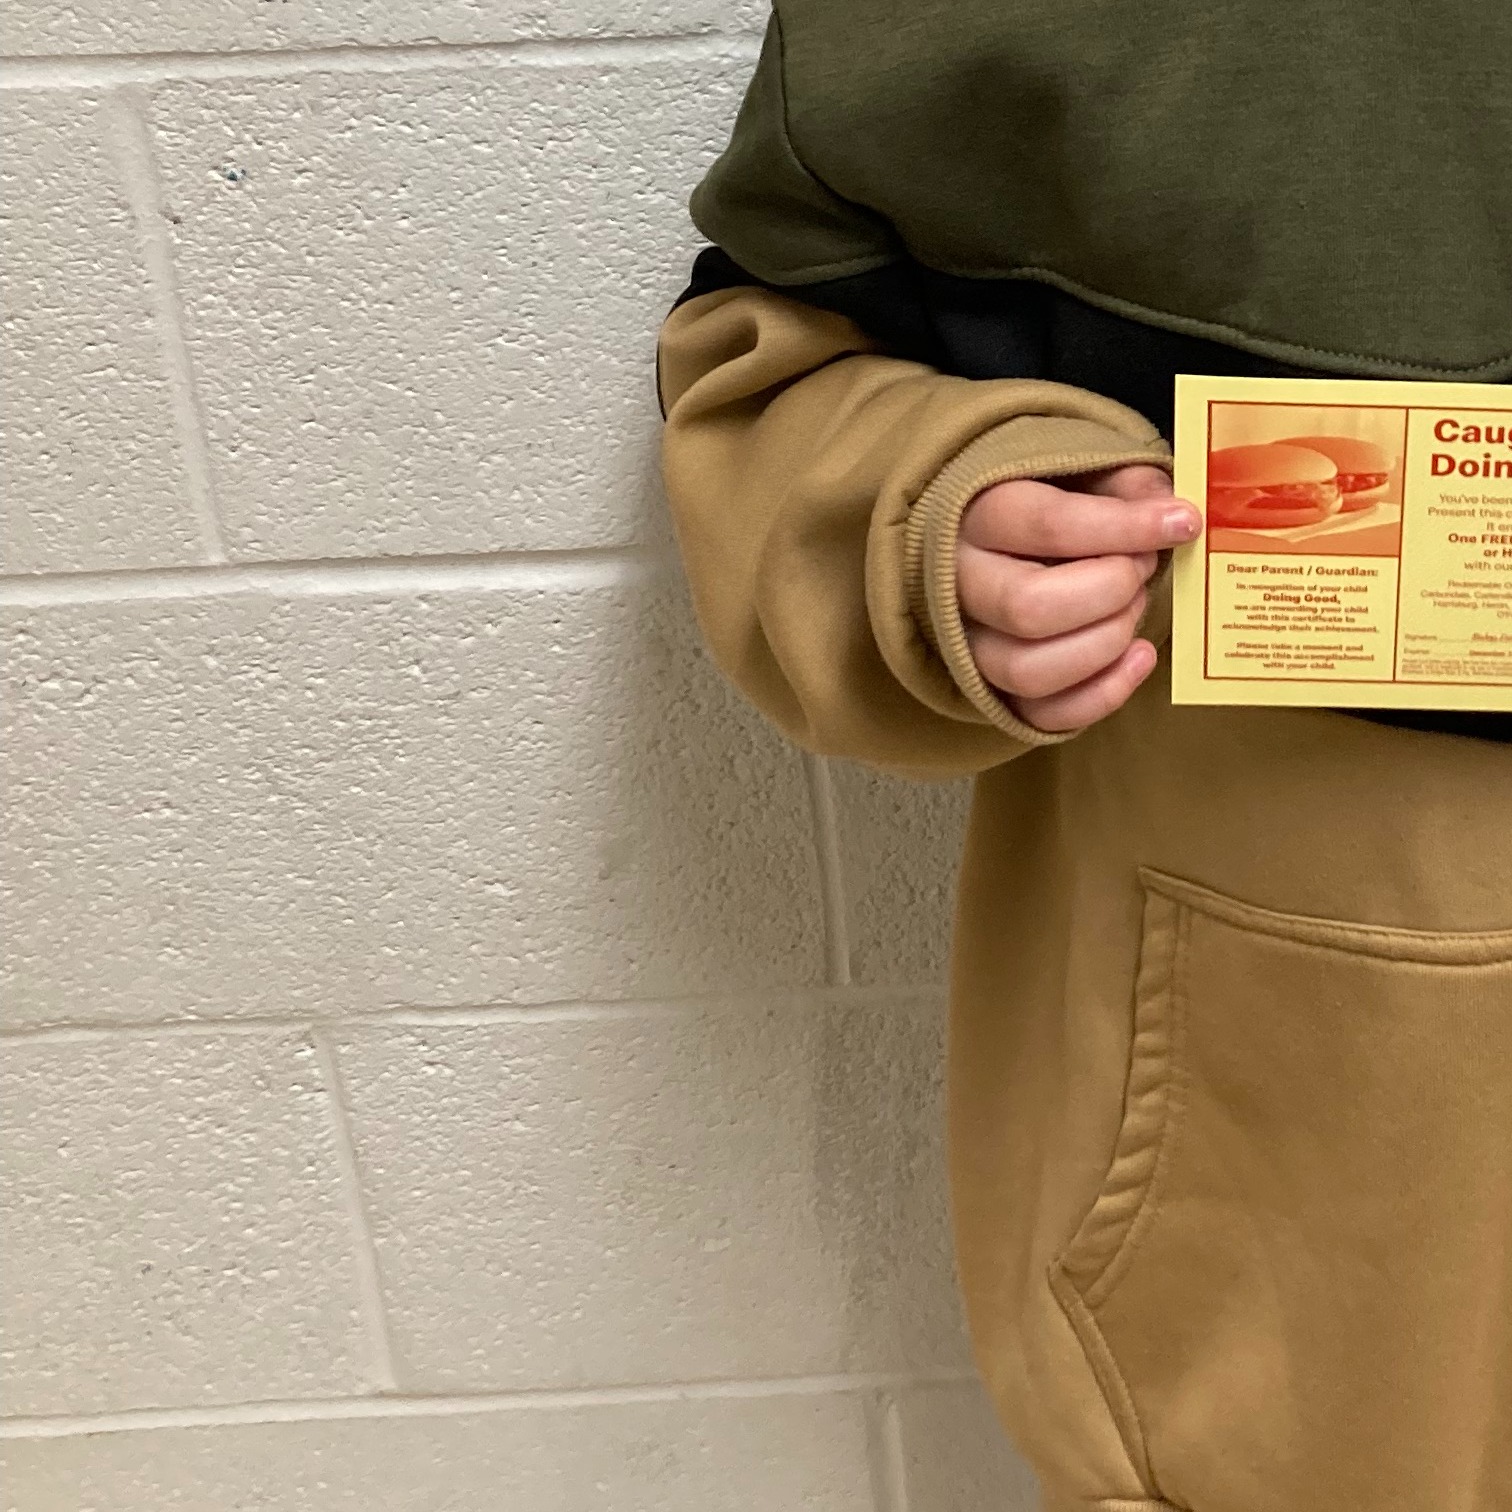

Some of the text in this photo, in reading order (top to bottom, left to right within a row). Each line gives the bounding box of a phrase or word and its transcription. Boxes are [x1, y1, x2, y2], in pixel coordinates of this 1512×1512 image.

[1439, 493, 1479, 505] You've
[1427, 506, 1476, 518] Present
[1479, 507, 1503, 519] this
[1448, 532, 1477, 544] One
[1483, 548, 1498, 558] or
[1227, 563, 1379, 577] Dear Parent / Guardian:
[1464, 560, 1491, 571] with
[1307, 584, 1317, 592] of
[1319, 585, 1342, 594] your
[1343, 585, 1368, 593] child
[1263, 592, 1341, 604] Doing Good,
[1320, 606, 1342, 615] your
[1344, 606, 1369, 614] child
[1246, 613, 1269, 621] with
[1271, 613, 1289, 622] this
[1345, 615, 1355, 623] to
[1345, 644, 1364, 652] and
[1262, 661, 1284, 669] with
[1286, 662, 1308, 671] your
